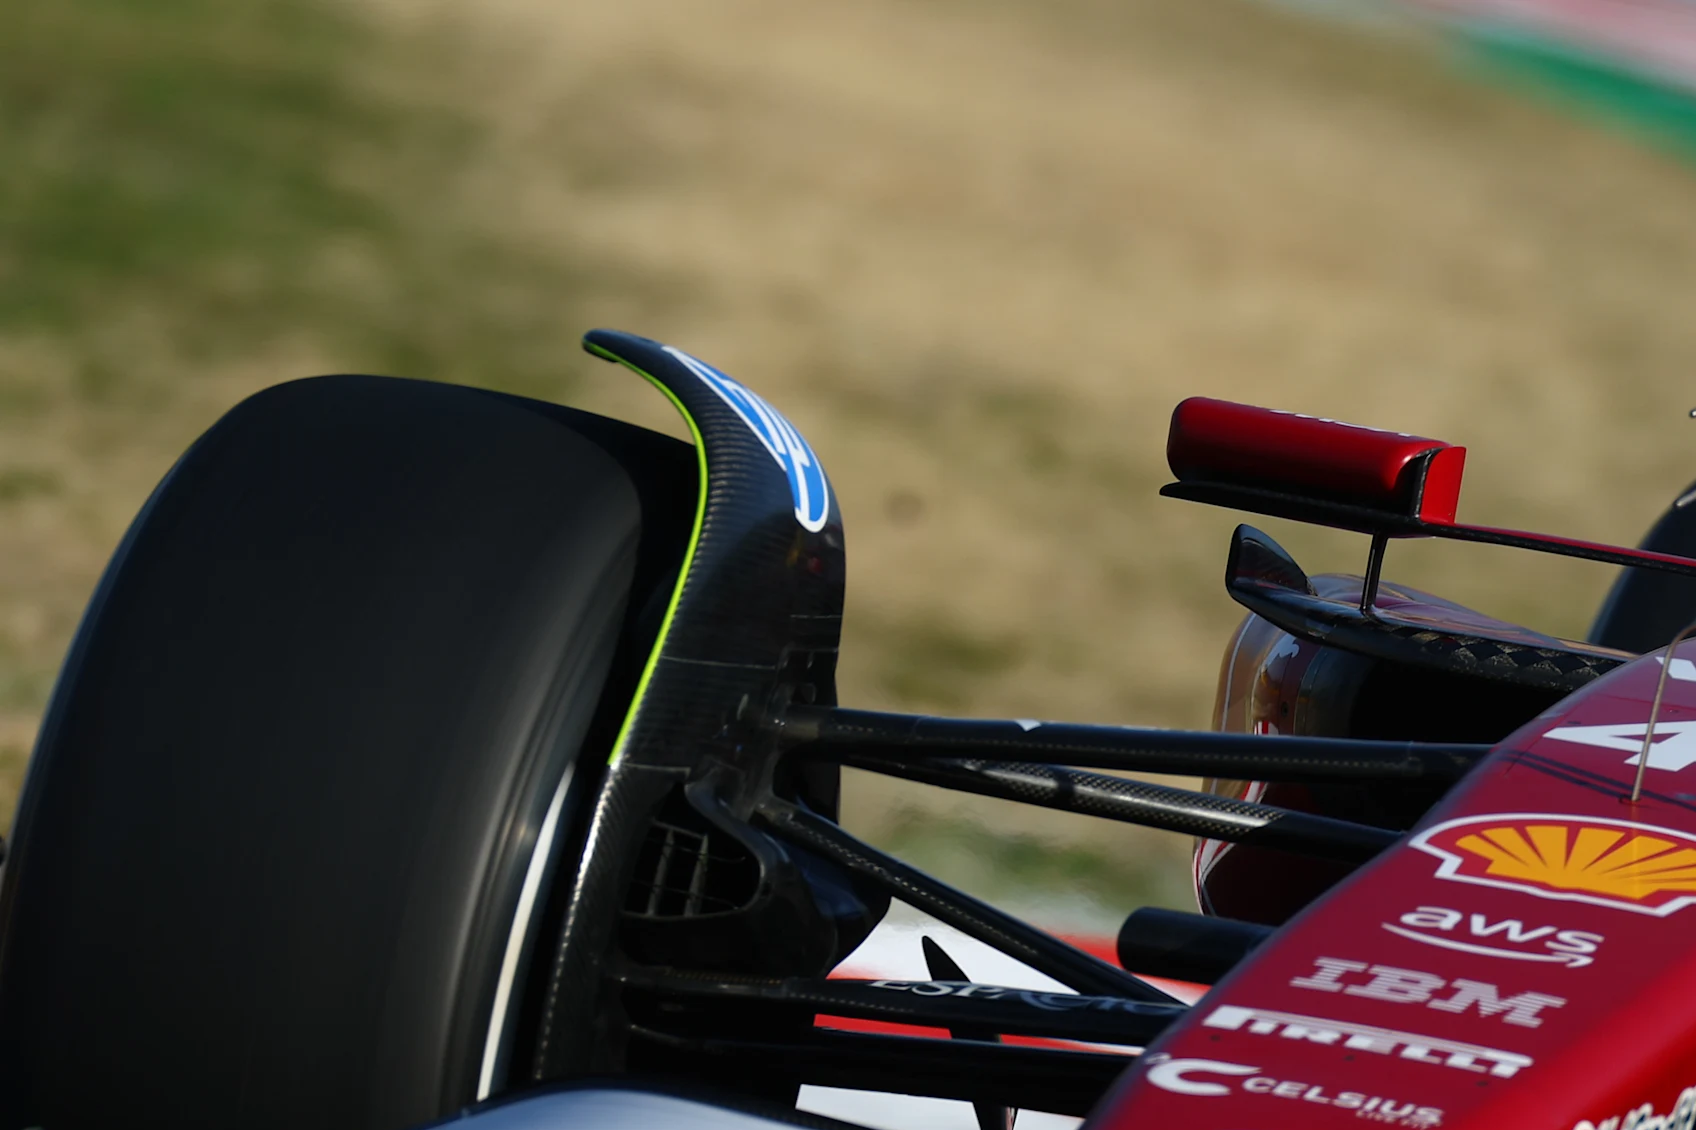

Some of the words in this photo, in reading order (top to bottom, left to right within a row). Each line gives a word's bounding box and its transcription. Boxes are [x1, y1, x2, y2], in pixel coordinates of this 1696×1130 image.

[1398, 905, 1605, 956] aws
[1290, 956, 1567, 1028] IBM
[1203, 1004, 1534, 1080] PIRELLI
[1241, 1076, 1445, 1127] CELSIUS
